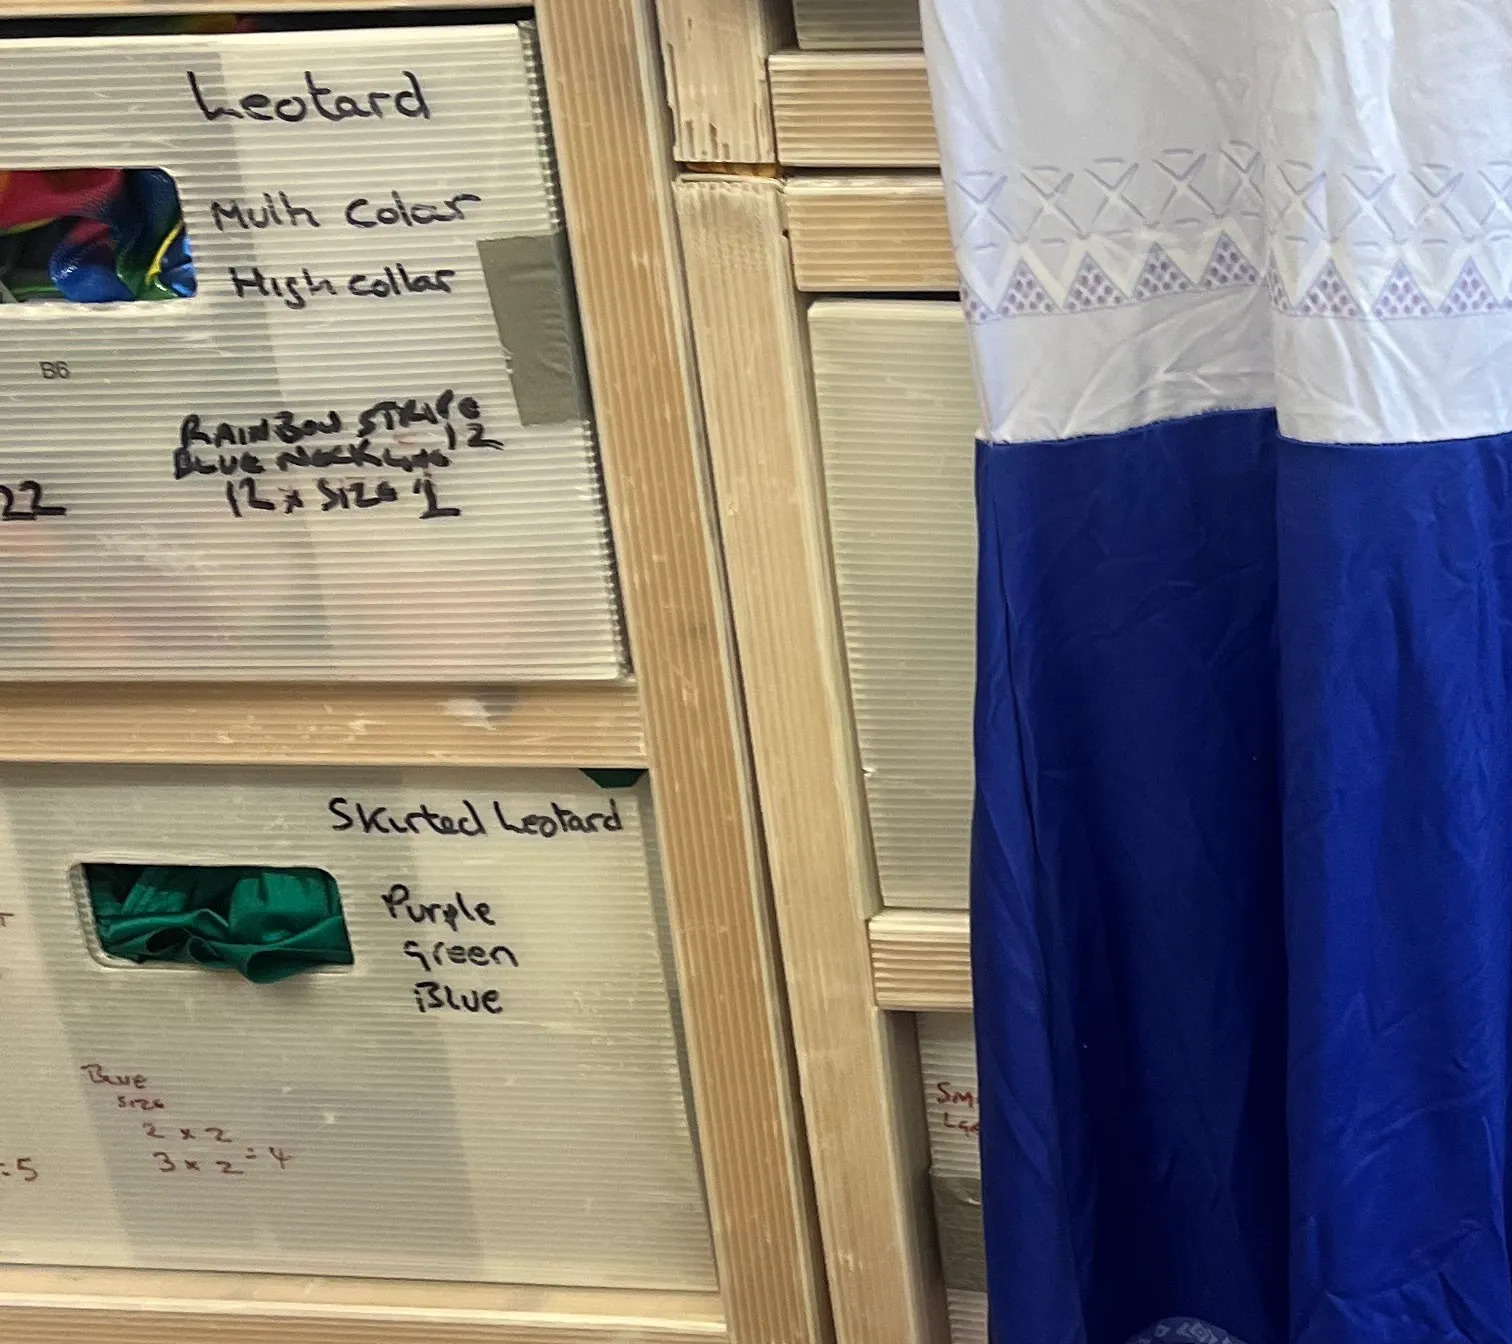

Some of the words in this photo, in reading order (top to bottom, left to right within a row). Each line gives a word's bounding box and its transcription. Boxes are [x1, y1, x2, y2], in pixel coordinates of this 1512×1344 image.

[187, 70, 431, 122] Leotard
[228, 265, 337, 310] High
[226, 477, 276, 518] 12
[328, 797, 487, 836] Skirted
[493, 798, 624, 838] Leotard
[381, 883, 496, 932] Purple
[17, 1157, 39, 1182] 5
[153, 1152, 176, 1173] 3
[268, 1147, 293, 1169] 4
